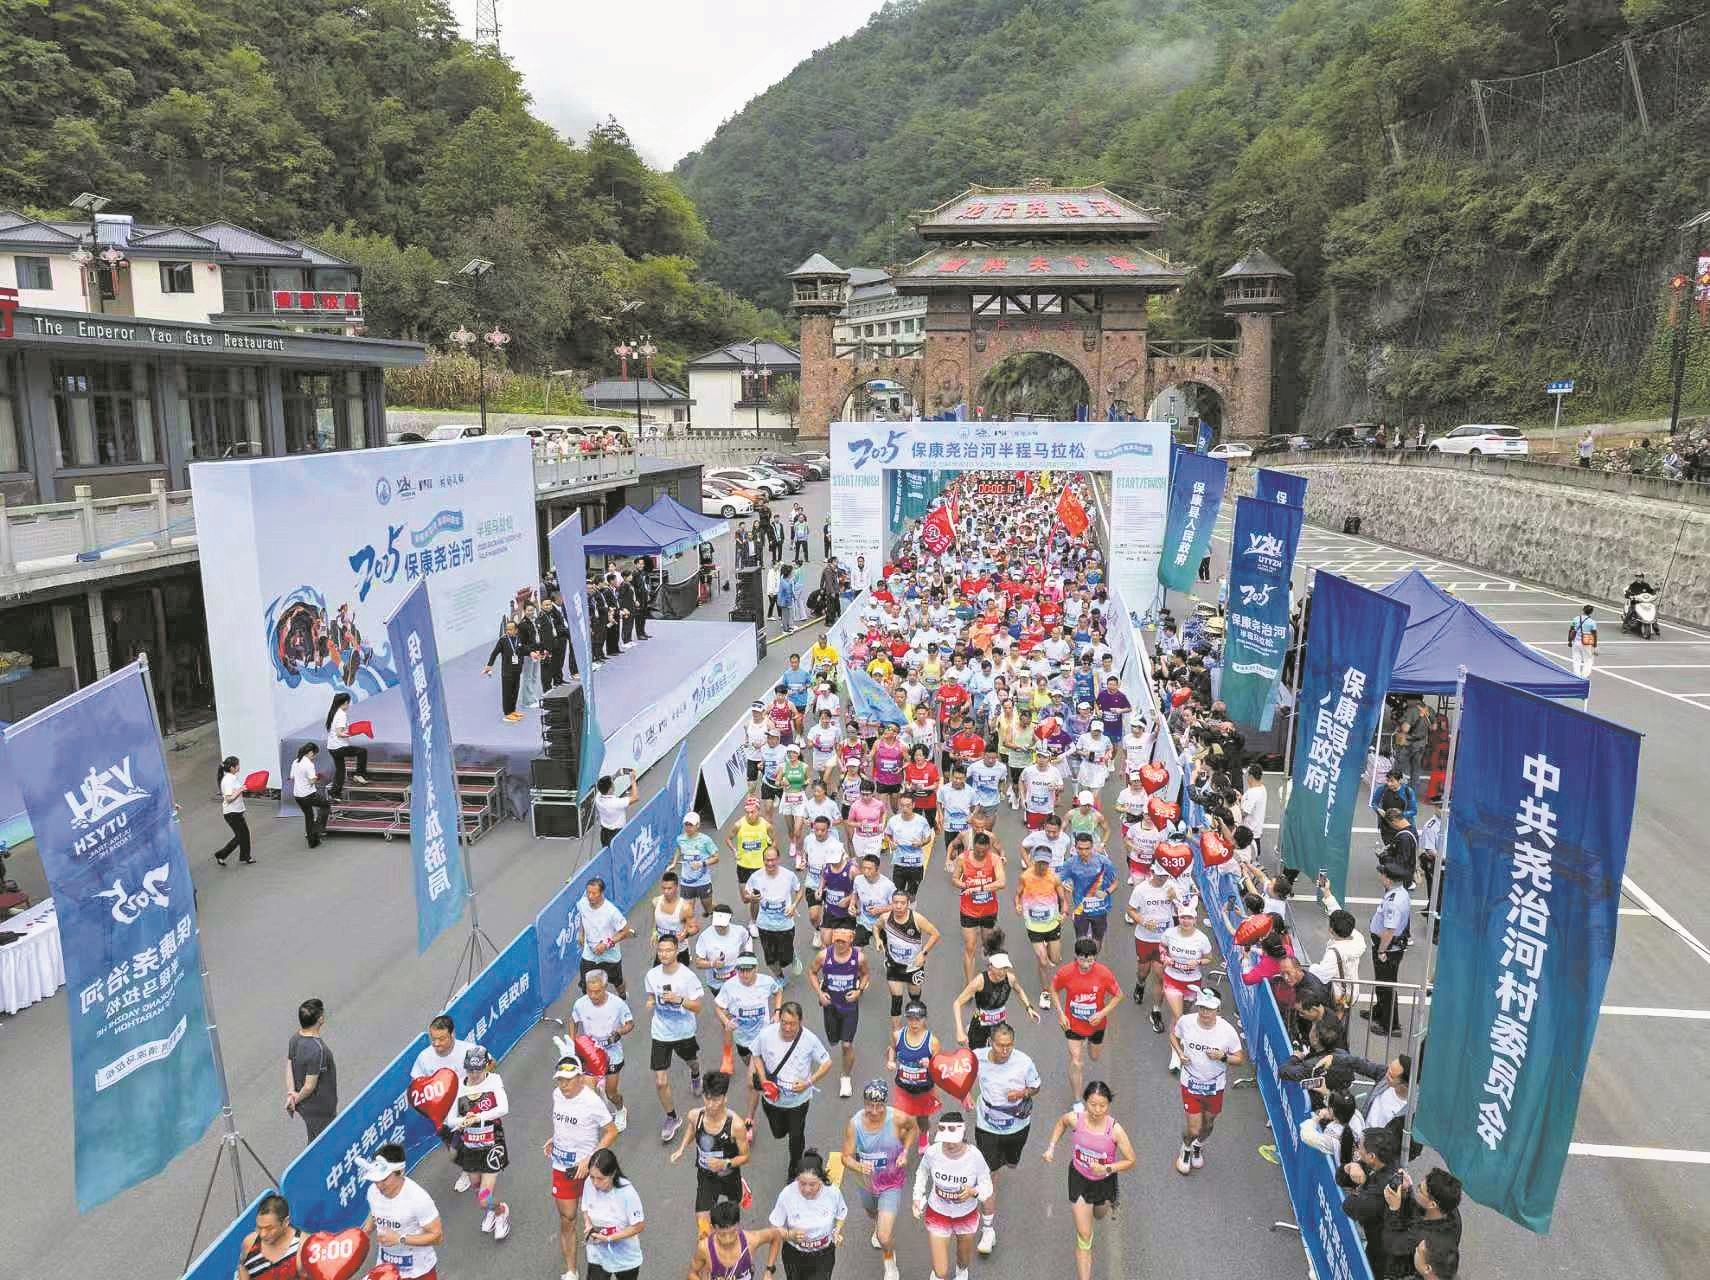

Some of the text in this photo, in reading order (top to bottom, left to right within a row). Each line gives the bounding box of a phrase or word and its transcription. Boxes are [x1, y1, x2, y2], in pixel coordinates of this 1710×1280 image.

[35, 317, 286, 351] The Emperor Yao Gate Restaurant
[911, 440, 1086, 460] 保康尧治河半程马拉松
[1173, 481, 1207, 567] 保康县人民政府
[404, 538, 474, 582] 保康尧治河
[1231, 612, 1287, 639] 保康尧治河
[1161, 857, 1186, 868] 3:30
[1477, 753, 1561, 1151] 中共尧治河村委员会
[411, 1081, 445, 1108] 2:00
[325, 1088, 409, 1192] 中共尧治河
[308, 1238, 354, 1265] 3:00
